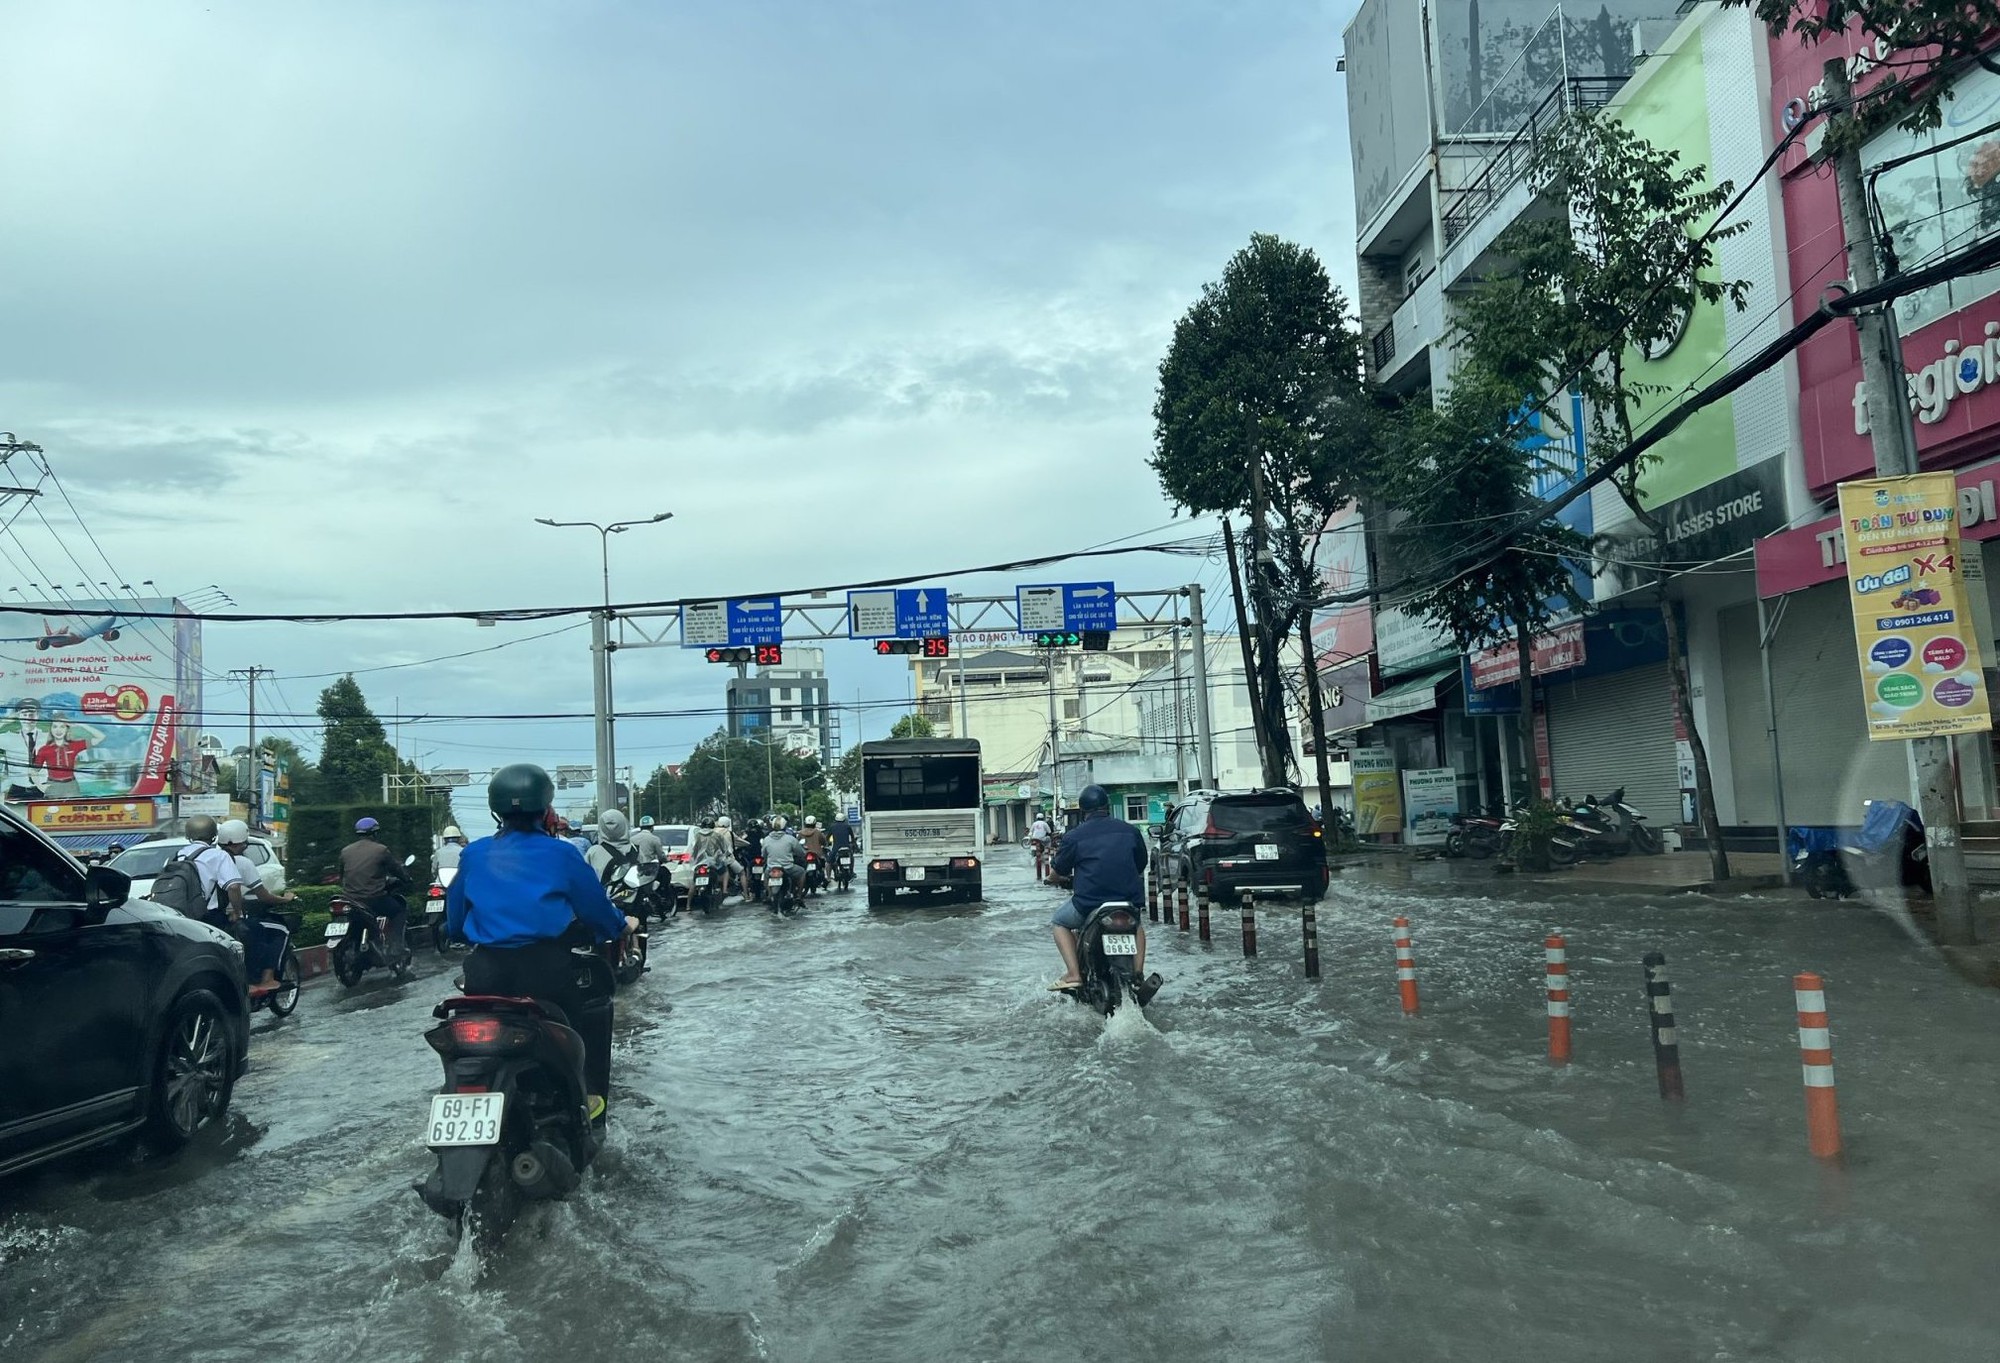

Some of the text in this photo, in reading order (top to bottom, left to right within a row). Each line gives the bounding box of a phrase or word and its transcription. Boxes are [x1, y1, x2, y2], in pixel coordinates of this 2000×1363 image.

[1716, 491, 1763, 524] STORE
[1922, 508, 1954, 523] DUY
[1856, 575, 1880, 593] Ưu
[1894, 613, 1949, 627] 0901 246 414
[956, 632, 976, 642] CAO
[1010, 632, 1017, 641] Y
[759, 647, 779, 664] 25
[928, 640, 947, 655] 35
[442, 1098, 491, 1118] 69-F1
[432, 1120, 496, 1142] 692.93
